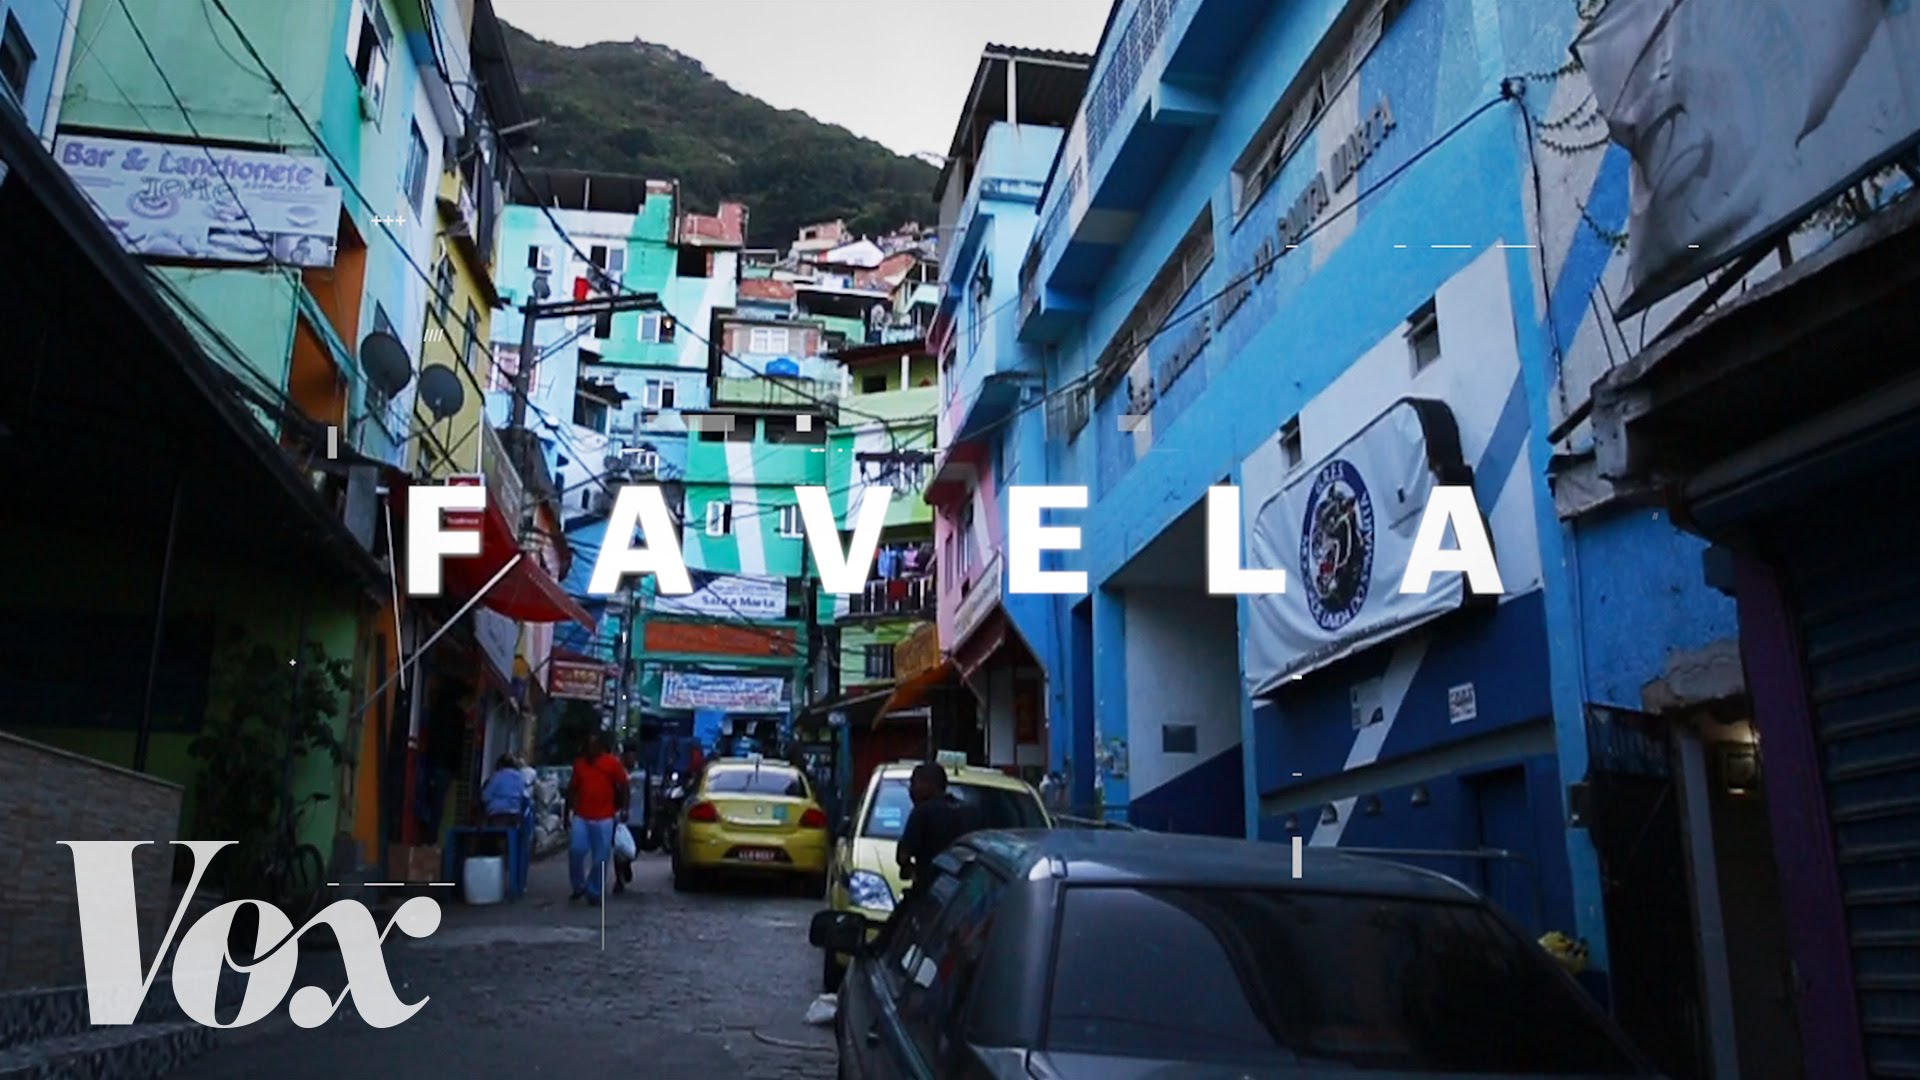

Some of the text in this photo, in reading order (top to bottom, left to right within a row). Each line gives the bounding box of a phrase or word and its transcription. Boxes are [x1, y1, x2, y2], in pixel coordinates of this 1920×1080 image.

[62, 141, 314, 185] Bar & Lanchonete
